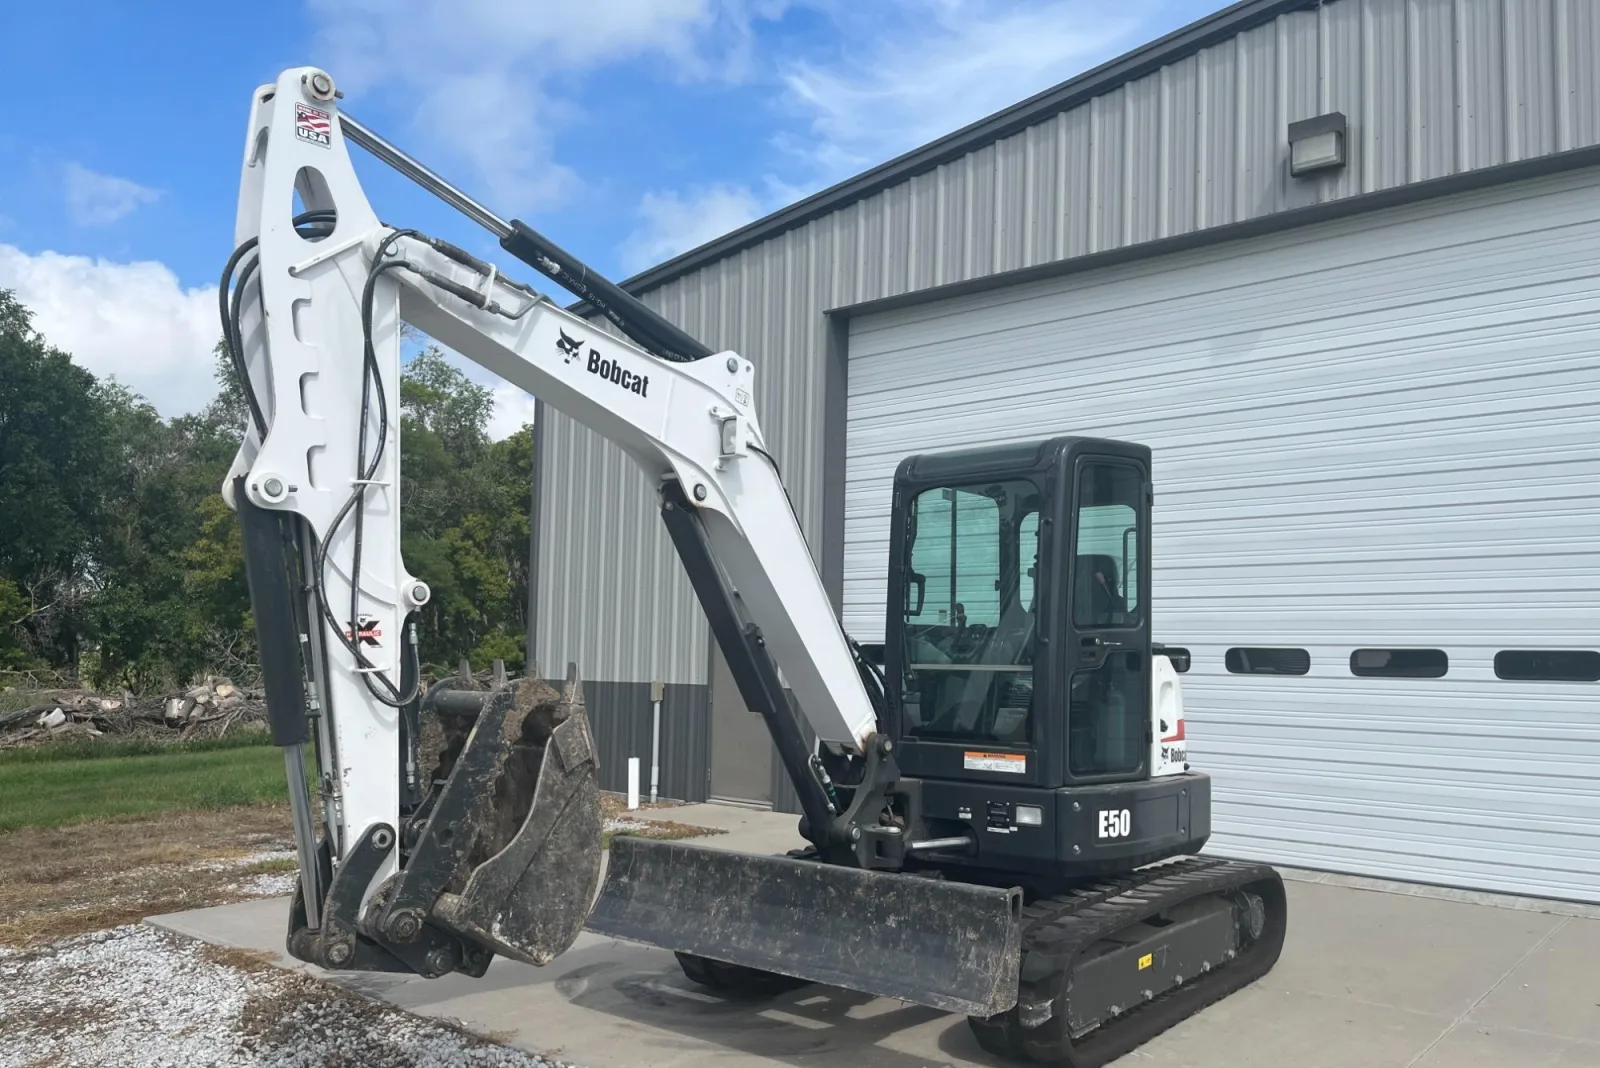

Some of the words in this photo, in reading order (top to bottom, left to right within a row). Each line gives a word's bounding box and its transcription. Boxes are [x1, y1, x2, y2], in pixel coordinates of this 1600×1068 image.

[298, 127, 328, 144] USA
[587, 348, 649, 398] Bobcat
[1098, 808, 1131, 838] E50
